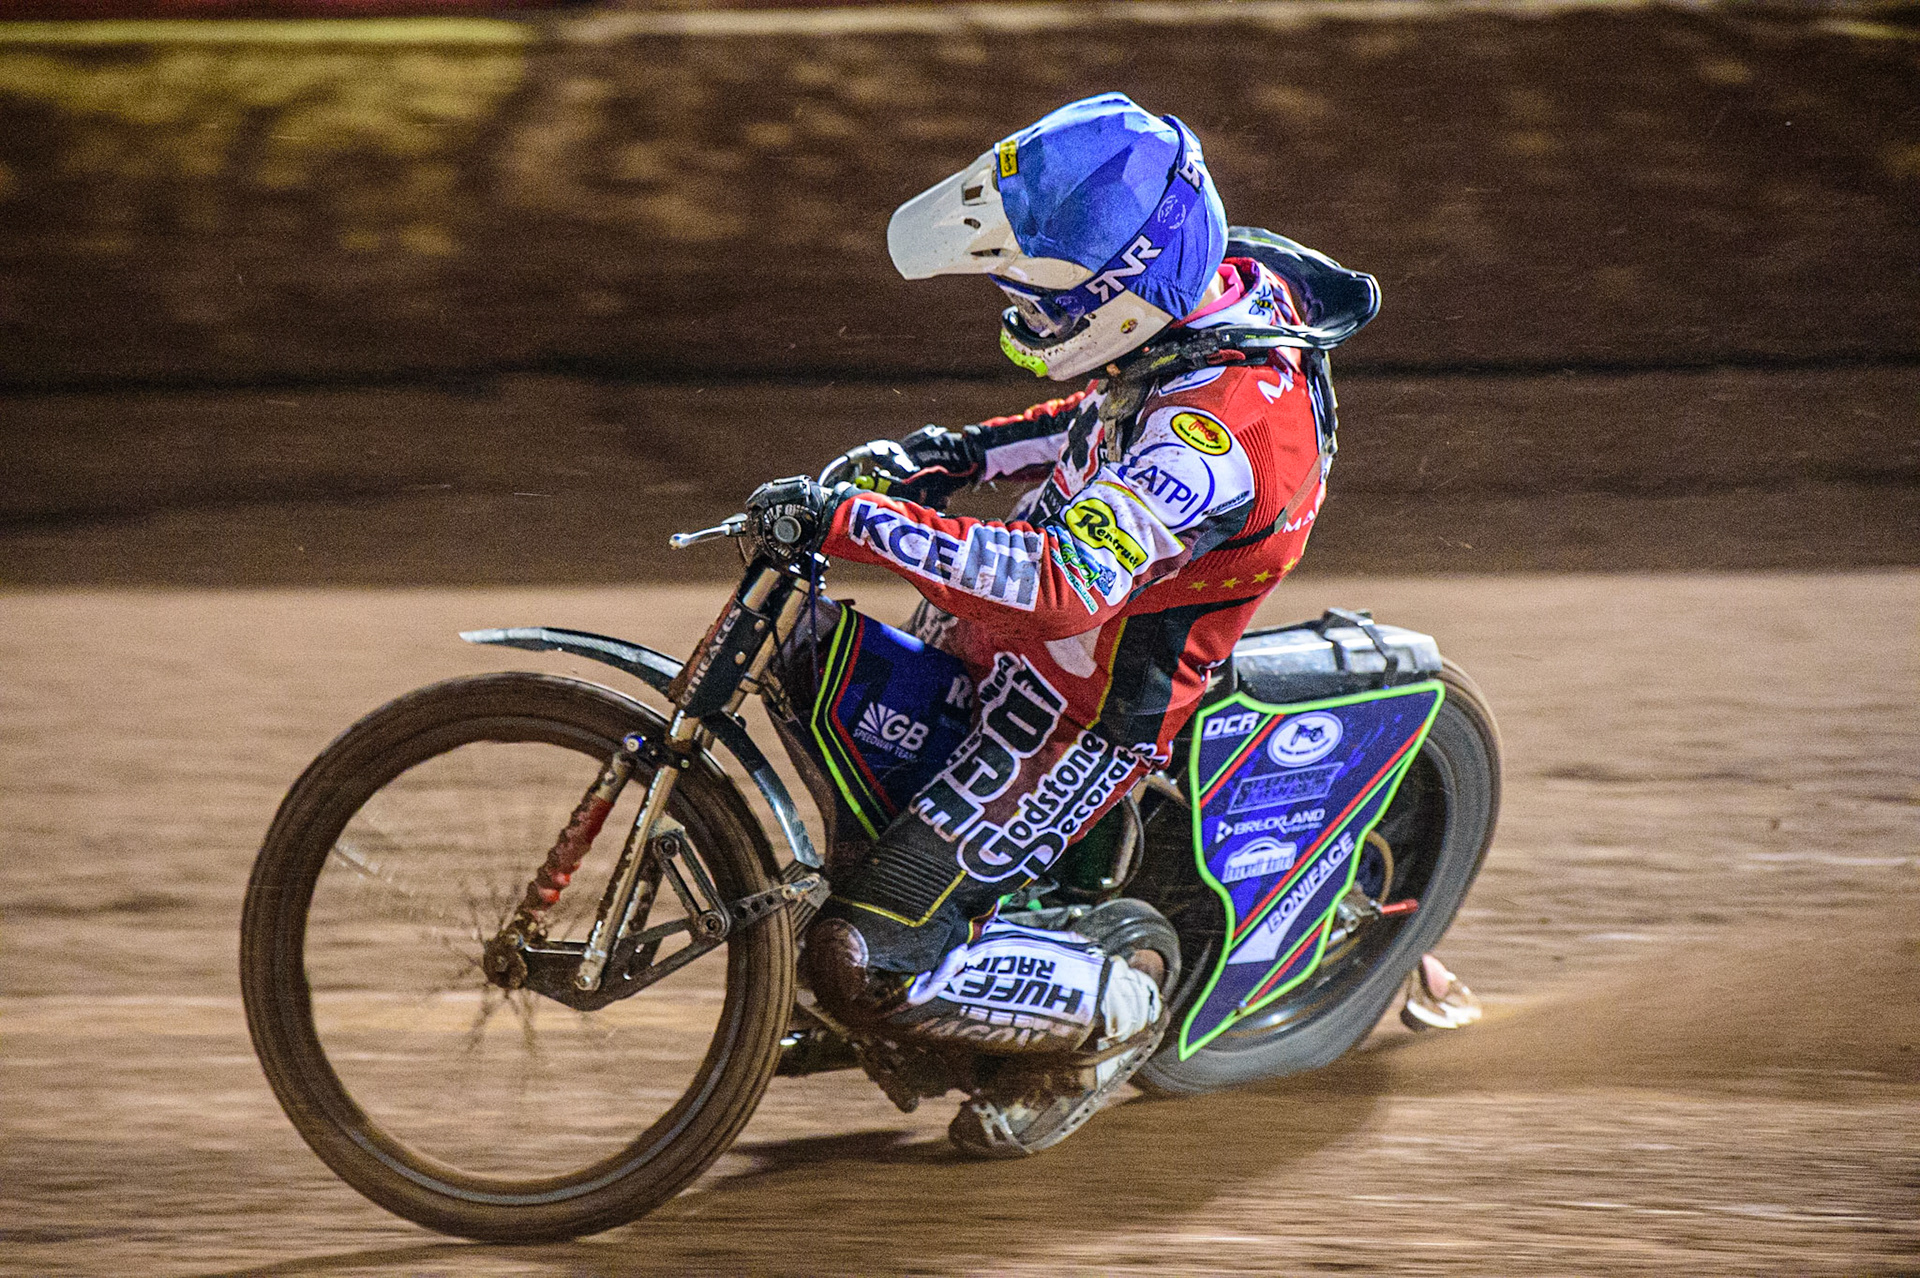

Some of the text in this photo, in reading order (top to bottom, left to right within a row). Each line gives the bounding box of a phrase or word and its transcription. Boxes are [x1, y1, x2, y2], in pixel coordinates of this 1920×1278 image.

[1124, 464, 1199, 514] ATPI
[853, 503, 959, 581] KCE
[853, 727, 918, 760] SPEEDWAY TEAM
[881, 714, 929, 751] GB
[1203, 712, 1260, 738] DCR
[957, 730, 1108, 882] Godstone
[1233, 808, 1326, 834] BRECKLAND
[1267, 831, 1356, 934] BONIFACE
